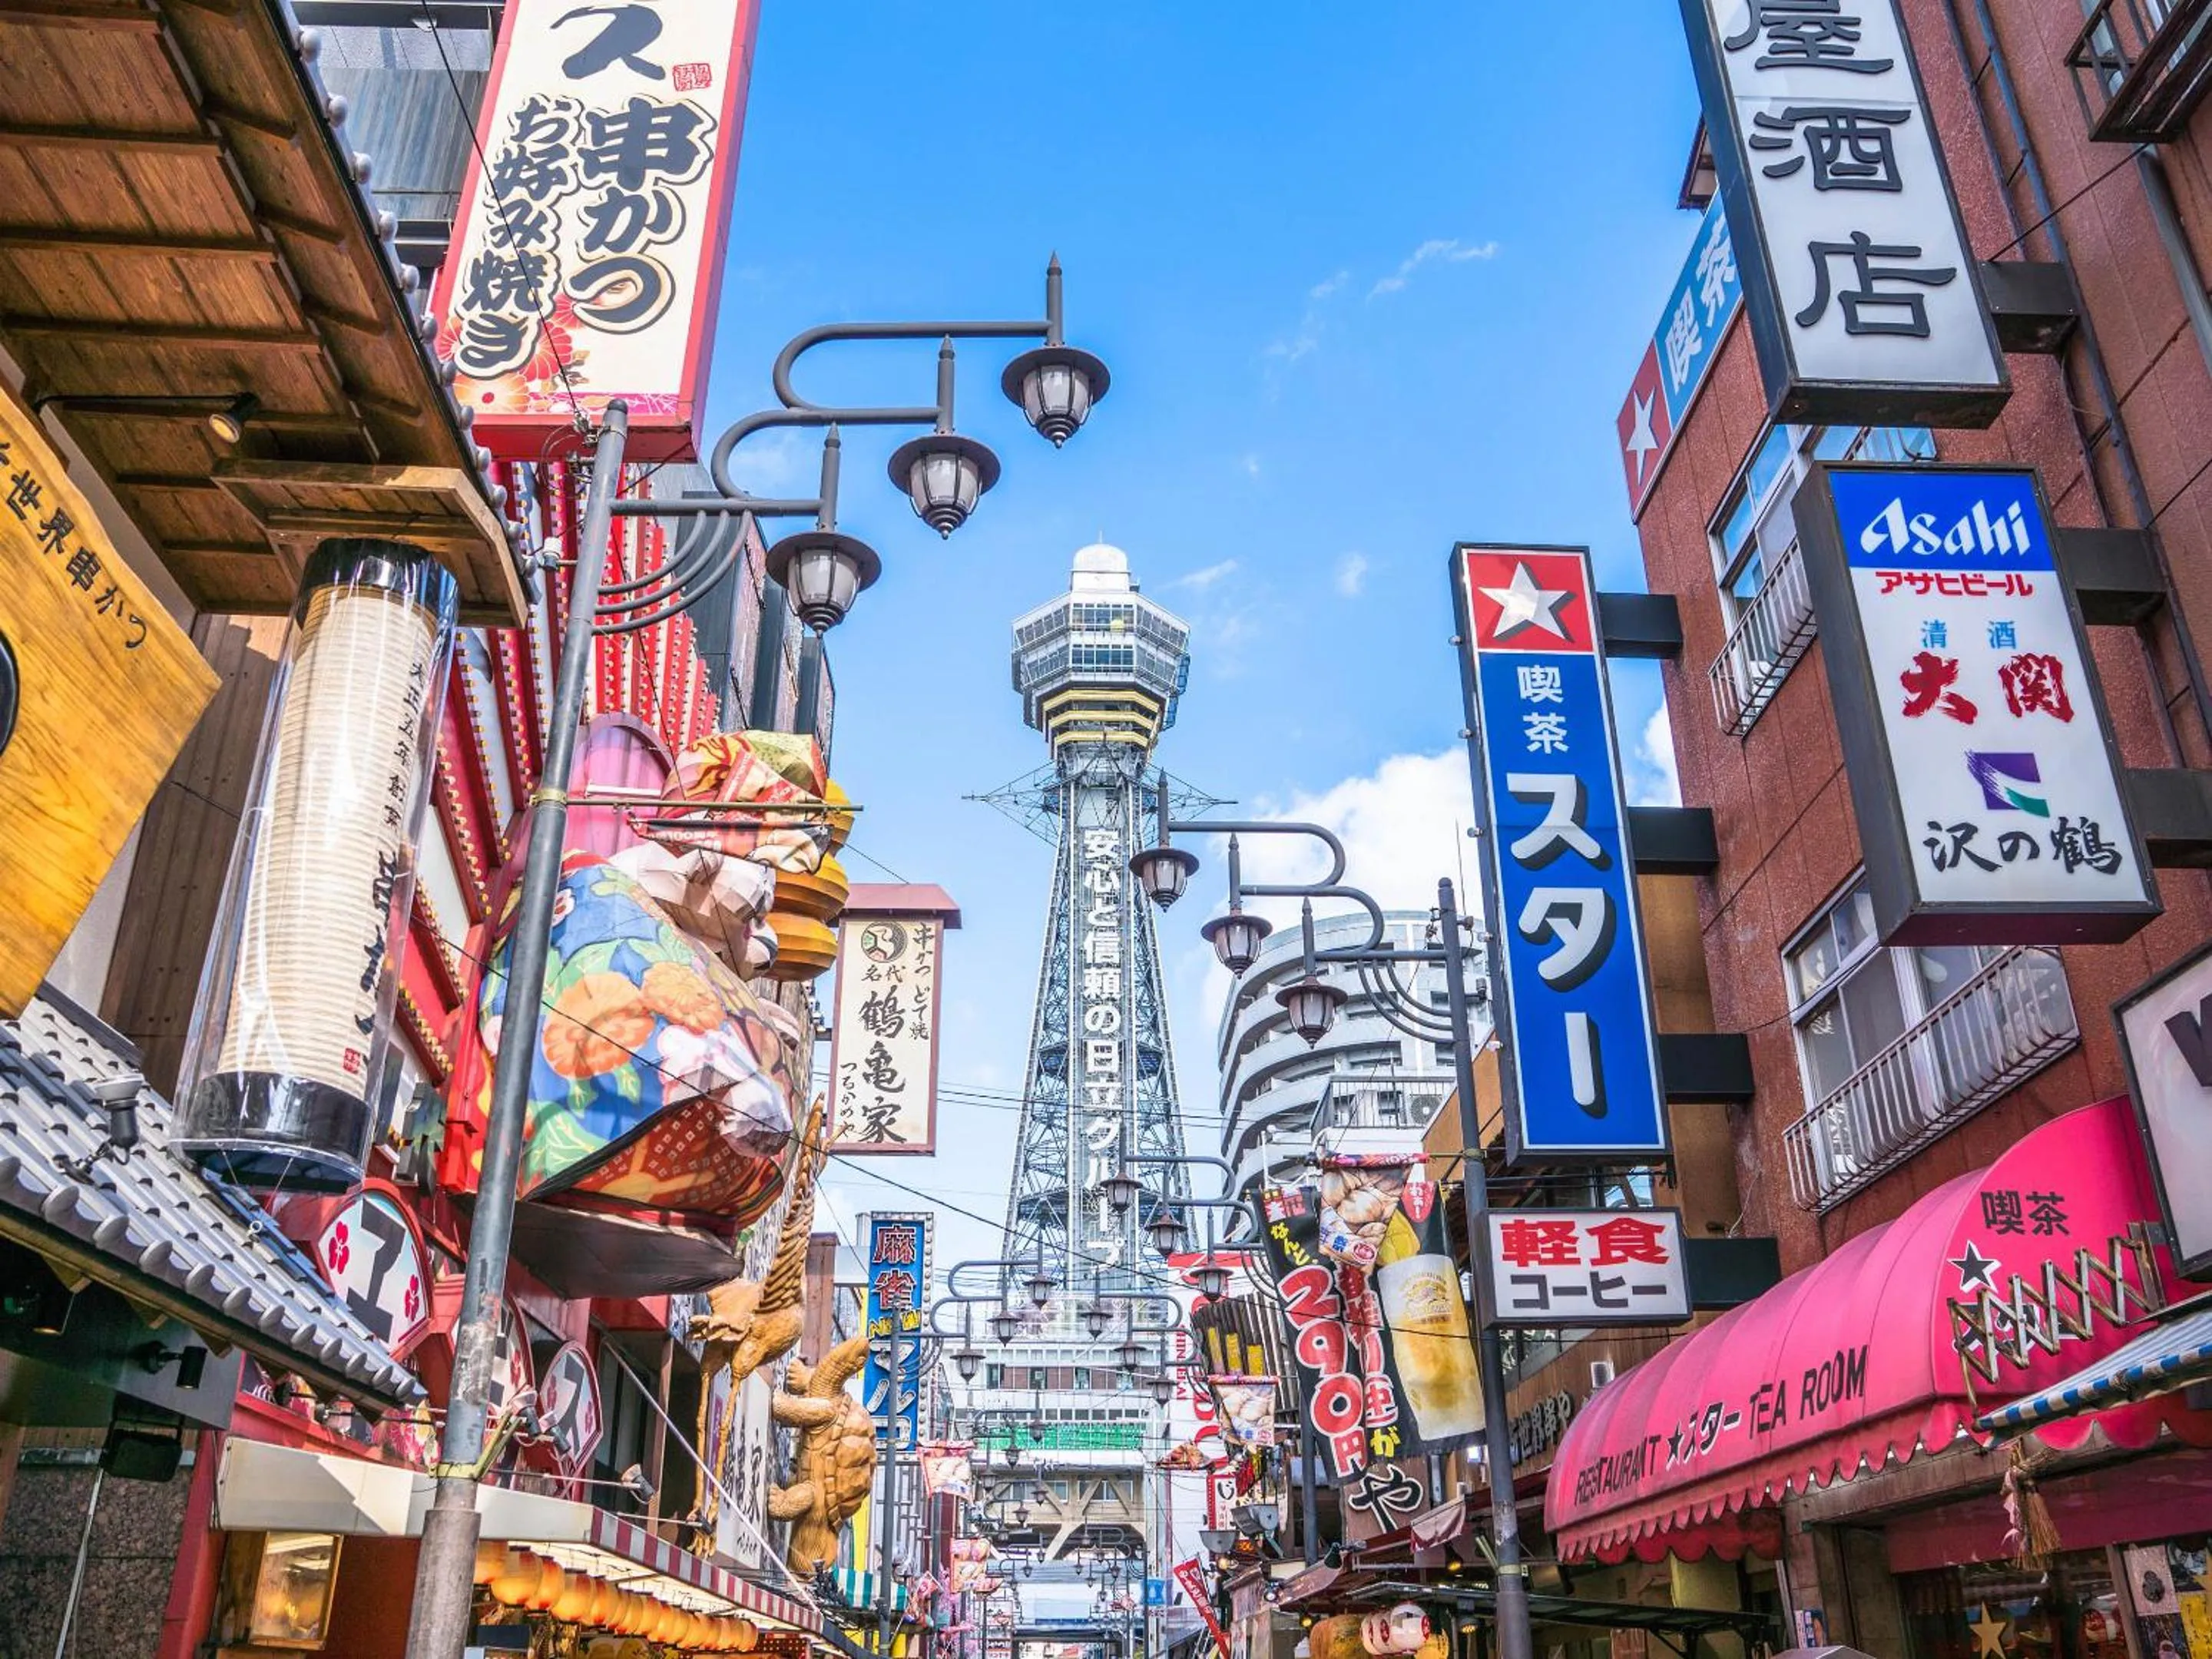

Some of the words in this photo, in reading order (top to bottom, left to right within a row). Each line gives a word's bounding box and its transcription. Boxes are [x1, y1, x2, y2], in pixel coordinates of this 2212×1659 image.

[550, 5, 666, 80] ス
[458, 95, 576, 372] お好み焼き
[567, 95, 710, 329] 串かつ
[1664, 210, 1737, 396] 喫茶
[0, 443, 147, 649] 世界串かつ
[1860, 497, 2032, 556] Asahi
[1875, 571, 2034, 597] アサヒビール
[1920, 620, 2018, 651] 清酒
[1516, 665, 1568, 755] 喫茶
[1900, 651, 2075, 726] 大関
[1922, 816, 2123, 876] 沢の鶴
[861, 965, 906, 983] 名代
[1506, 773, 1611, 1112] スター
[858, 985, 908, 1144] 鶴亀家
[1500, 1217, 1670, 1267] 軽食
[1980, 1190, 2071, 1237] 喫茶
[872, 1224, 916, 1310] 麻雀
[1510, 1271, 1667, 1310] コーヒー
[1277, 1264, 1368, 1479] 290円
[1574, 1434, 1661, 1506] RESTAURANT
[1749, 1379, 1787, 1439] TEA
[1799, 1344, 1869, 1420] ROOM
